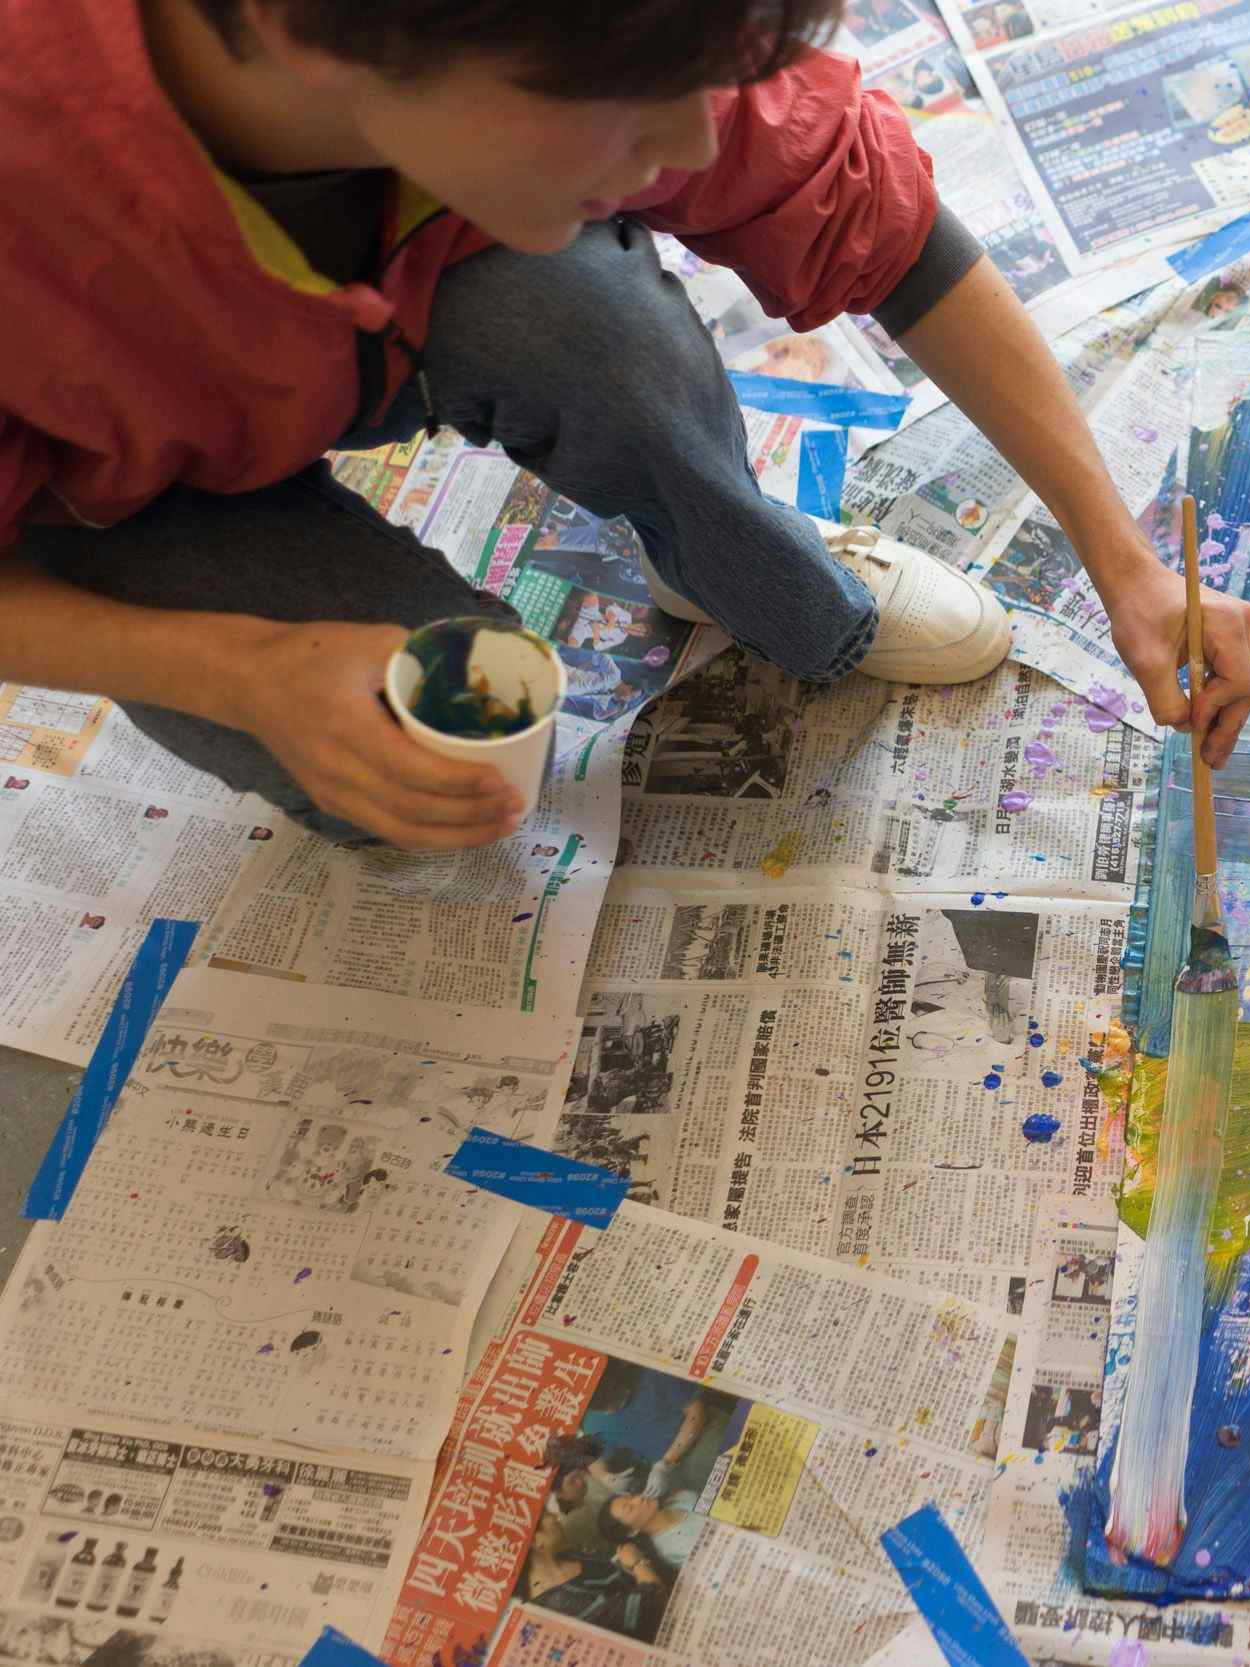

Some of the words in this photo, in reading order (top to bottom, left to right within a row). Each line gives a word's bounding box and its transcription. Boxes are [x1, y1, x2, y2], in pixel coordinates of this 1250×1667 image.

[739, 1008, 778, 1143] 法院首判國家賠償
[852, 911, 922, 1176] 日本2191位醫師無薪
[408, 1339, 553, 1600] 四天培訓就出師
